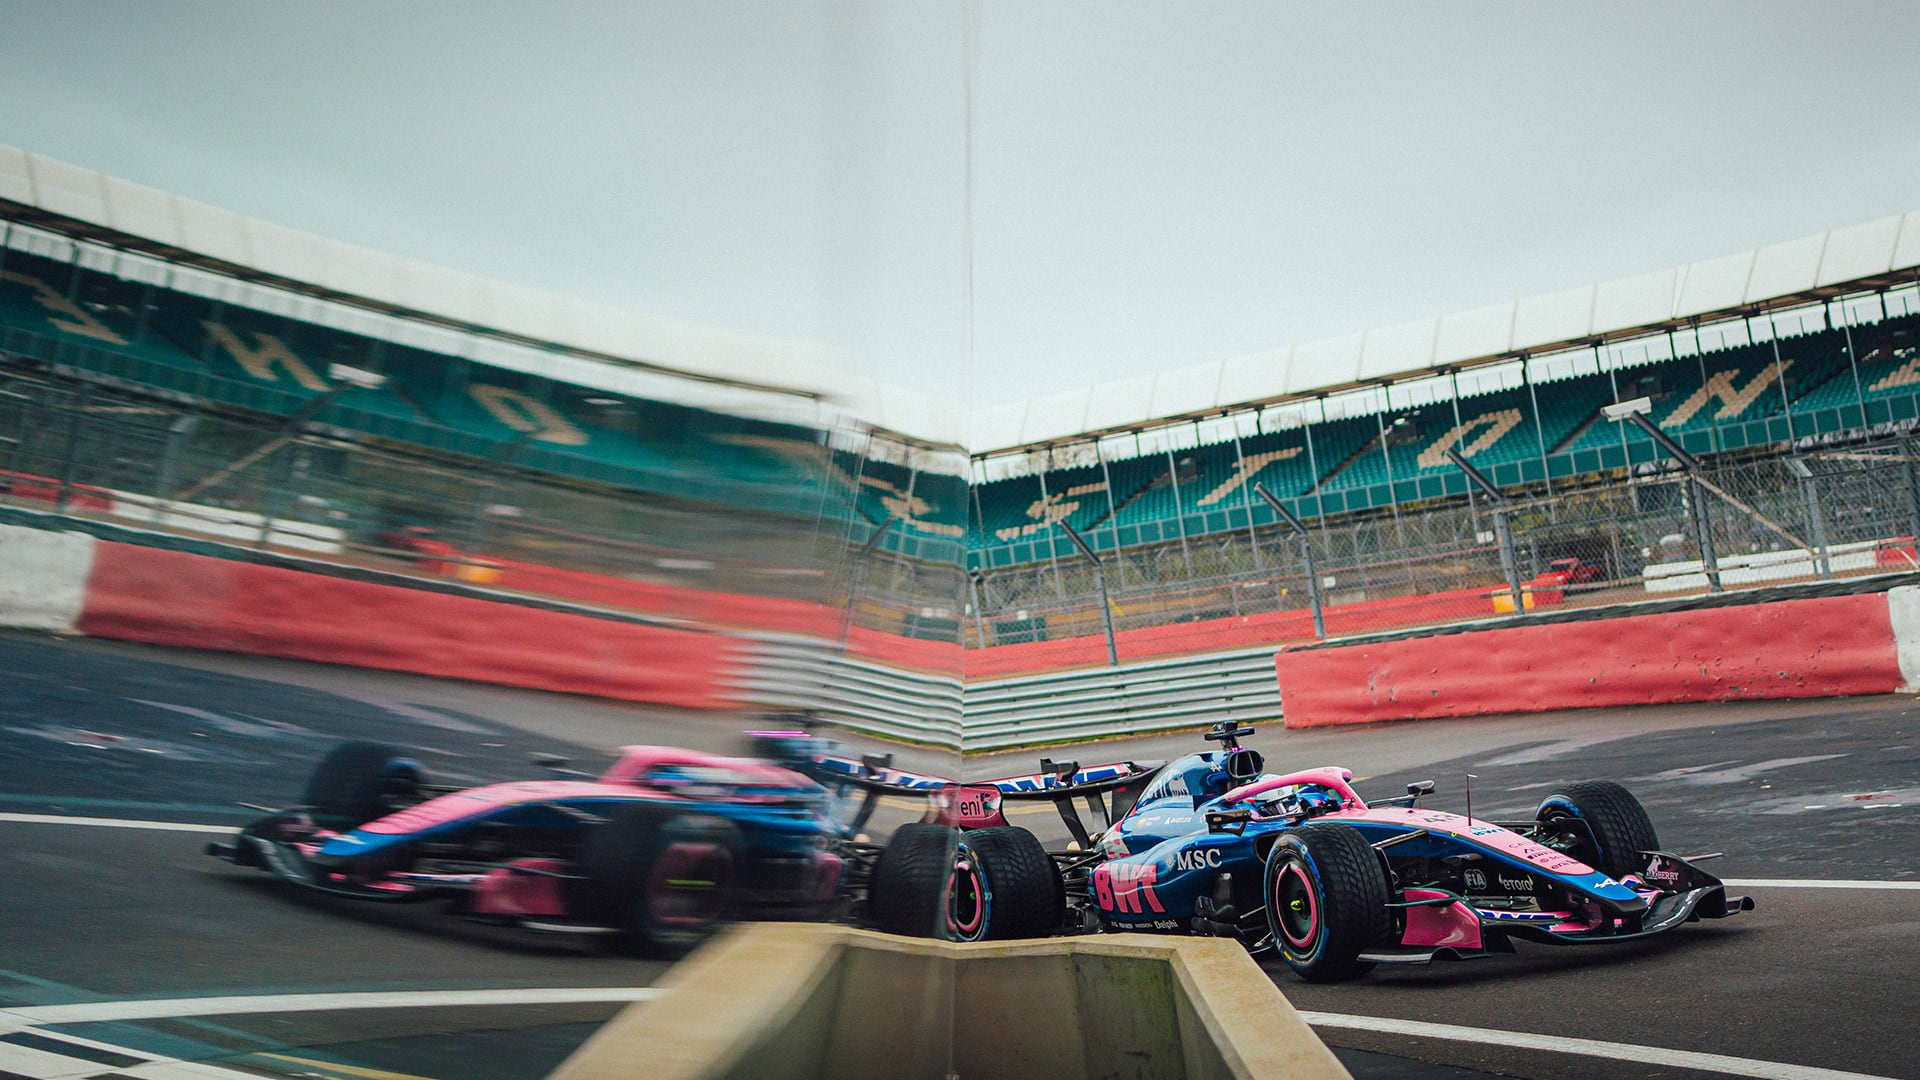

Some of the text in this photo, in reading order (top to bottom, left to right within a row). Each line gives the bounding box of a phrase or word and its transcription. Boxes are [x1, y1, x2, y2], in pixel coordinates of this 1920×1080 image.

[961, 795, 980, 816] eni
[1176, 849, 1223, 871] MSC
[1094, 863, 1166, 914] BWT
[1465, 873, 1486, 886] FIA
[1153, 919, 1179, 930] Delphi
